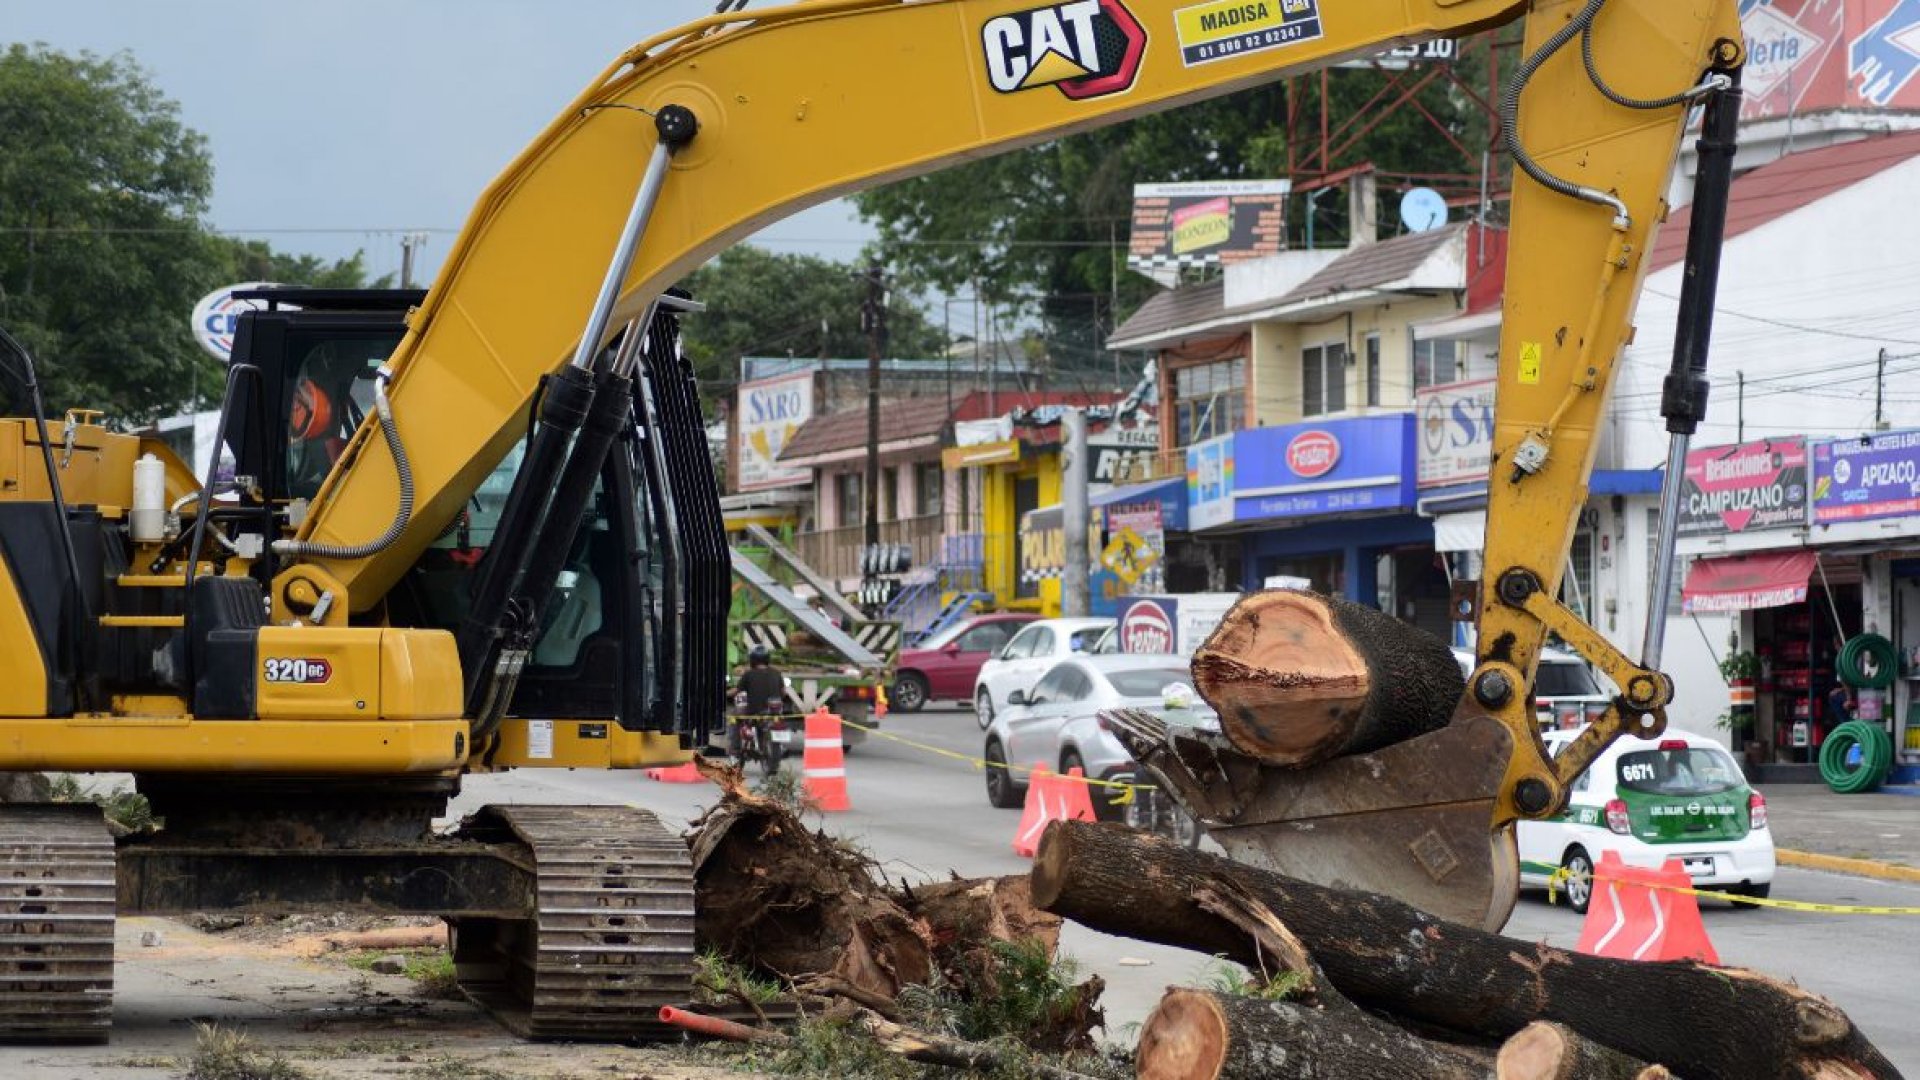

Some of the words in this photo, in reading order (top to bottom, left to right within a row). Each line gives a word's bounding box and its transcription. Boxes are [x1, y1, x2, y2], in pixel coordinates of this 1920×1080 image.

[1200, 2, 1268, 31] MADISA
[984, 0, 1099, 91] CAT
[1200, 45, 1213, 57] 01
[1423, 38, 1453, 58] 10
[1750, 31, 1799, 66] leria
[1451, 396, 1494, 448] SA
[1861, 460, 1915, 487] APIZACO
[1690, 483, 1783, 516] CAMPUZANO
[264, 659, 307, 682] 320
[308, 665, 325, 678] GC
[1622, 763, 1655, 782] 6671
